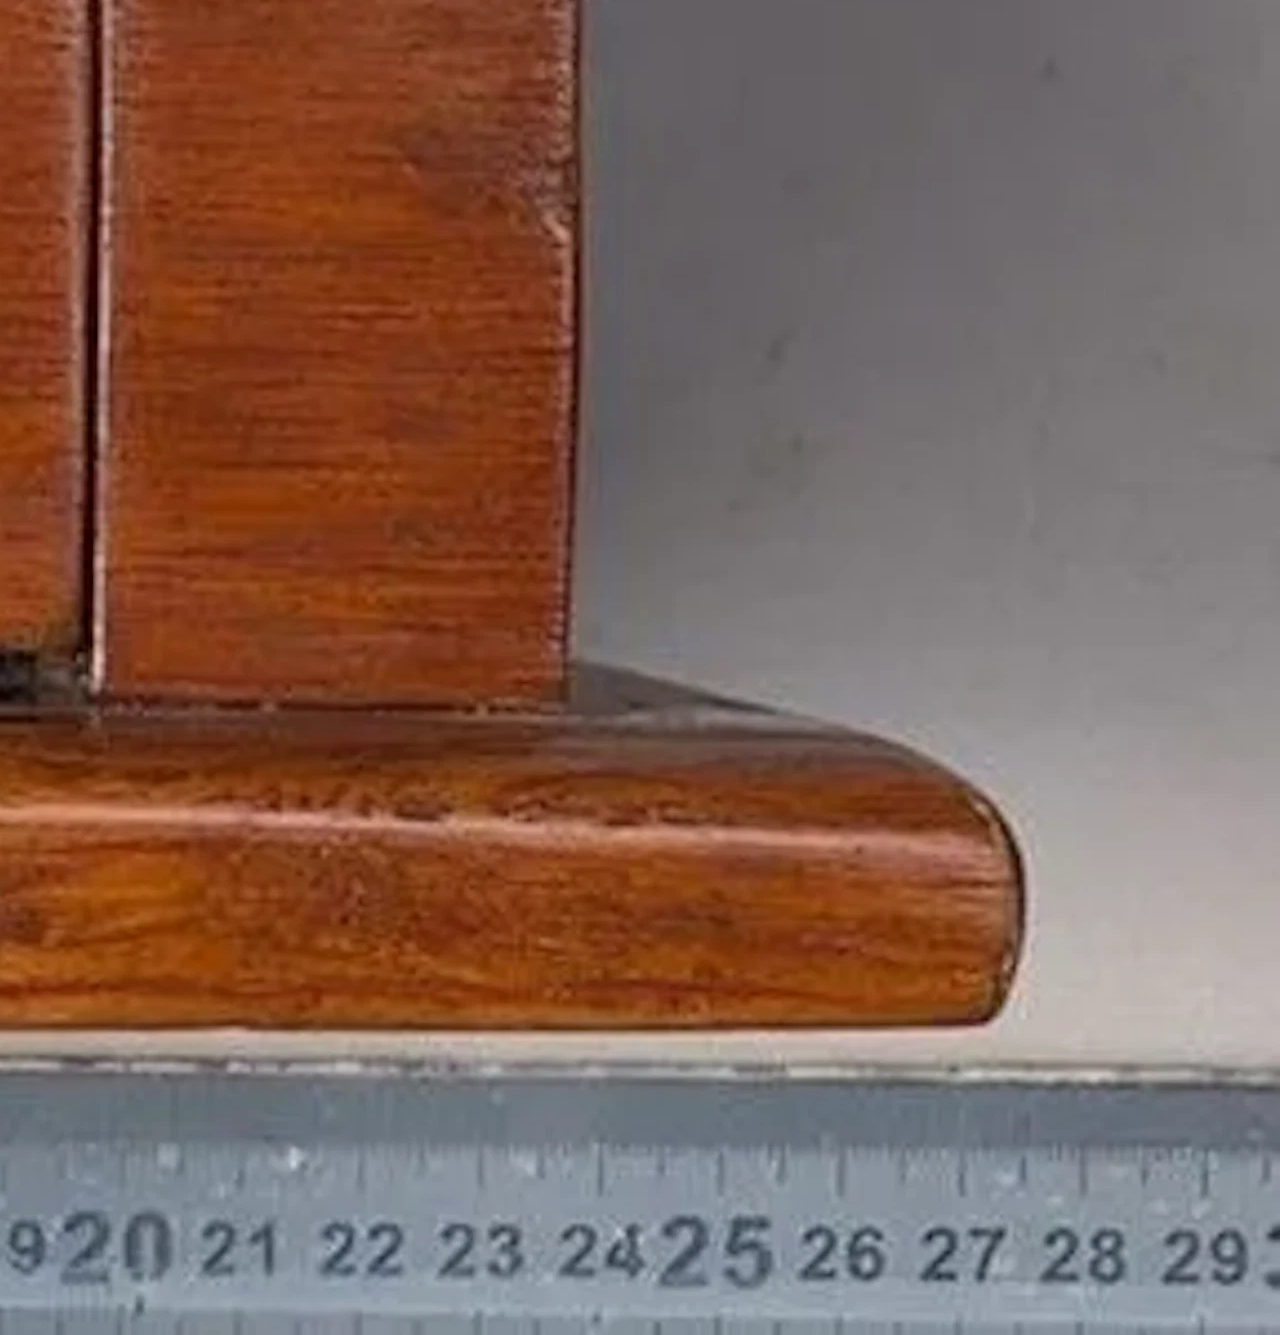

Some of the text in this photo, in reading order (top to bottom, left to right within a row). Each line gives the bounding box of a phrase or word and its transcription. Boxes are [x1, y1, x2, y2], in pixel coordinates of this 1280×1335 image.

[62, 1210, 172, 1284] 20
[202, 1222, 276, 1275] 21
[321, 1222, 404, 1277] 22
[440, 1223, 523, 1278] 23
[559, 1224, 644, 1278] 24
[657, 1216, 773, 1289] 25
[799, 1226, 885, 1281] 26
[920, 1227, 1006, 1282] 27
[1044, 1228, 1127, 1285] 28
[1162, 1228, 1248, 1286] 29
